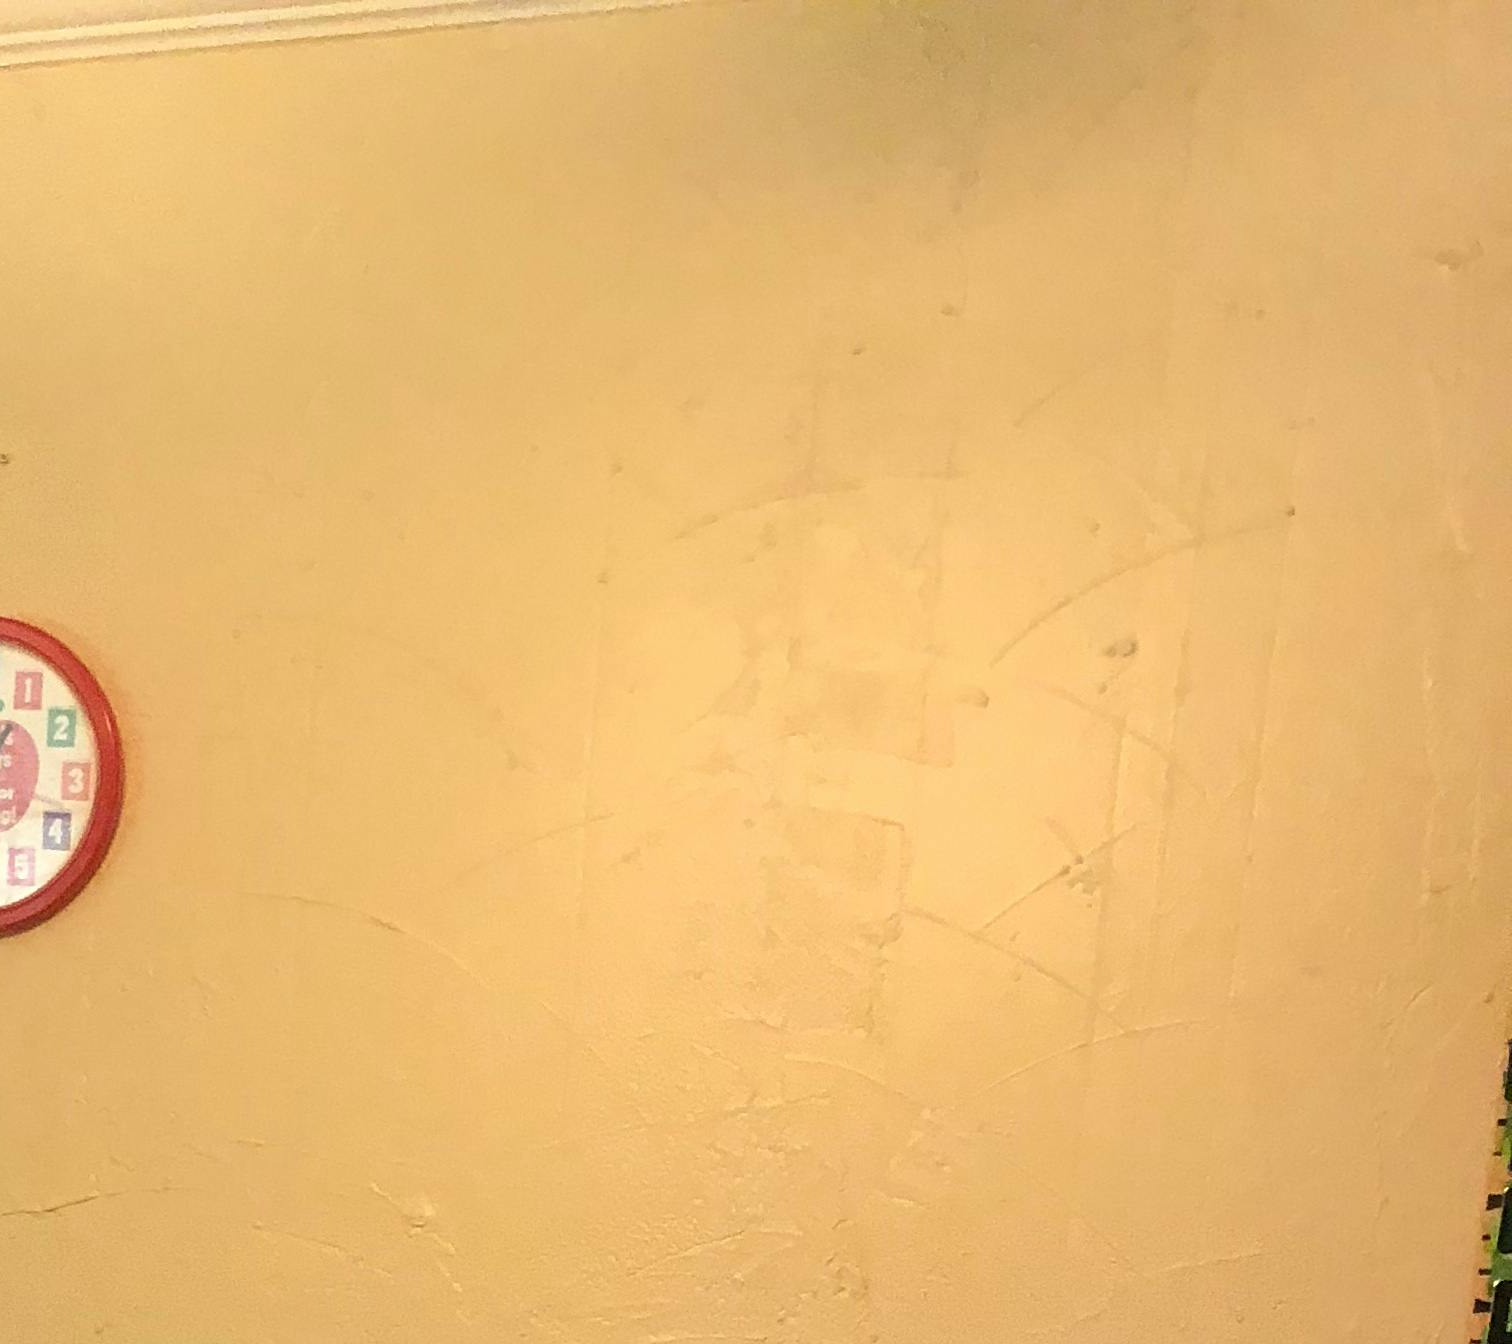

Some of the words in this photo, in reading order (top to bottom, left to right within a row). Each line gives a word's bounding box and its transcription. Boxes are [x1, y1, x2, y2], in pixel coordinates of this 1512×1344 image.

[24, 678, 32, 703] 1
[56, 715, 68, 740] 2
[68, 769, 83, 792] 3
[49, 818, 61, 843] 4
[15, 855, 28, 878] 5
